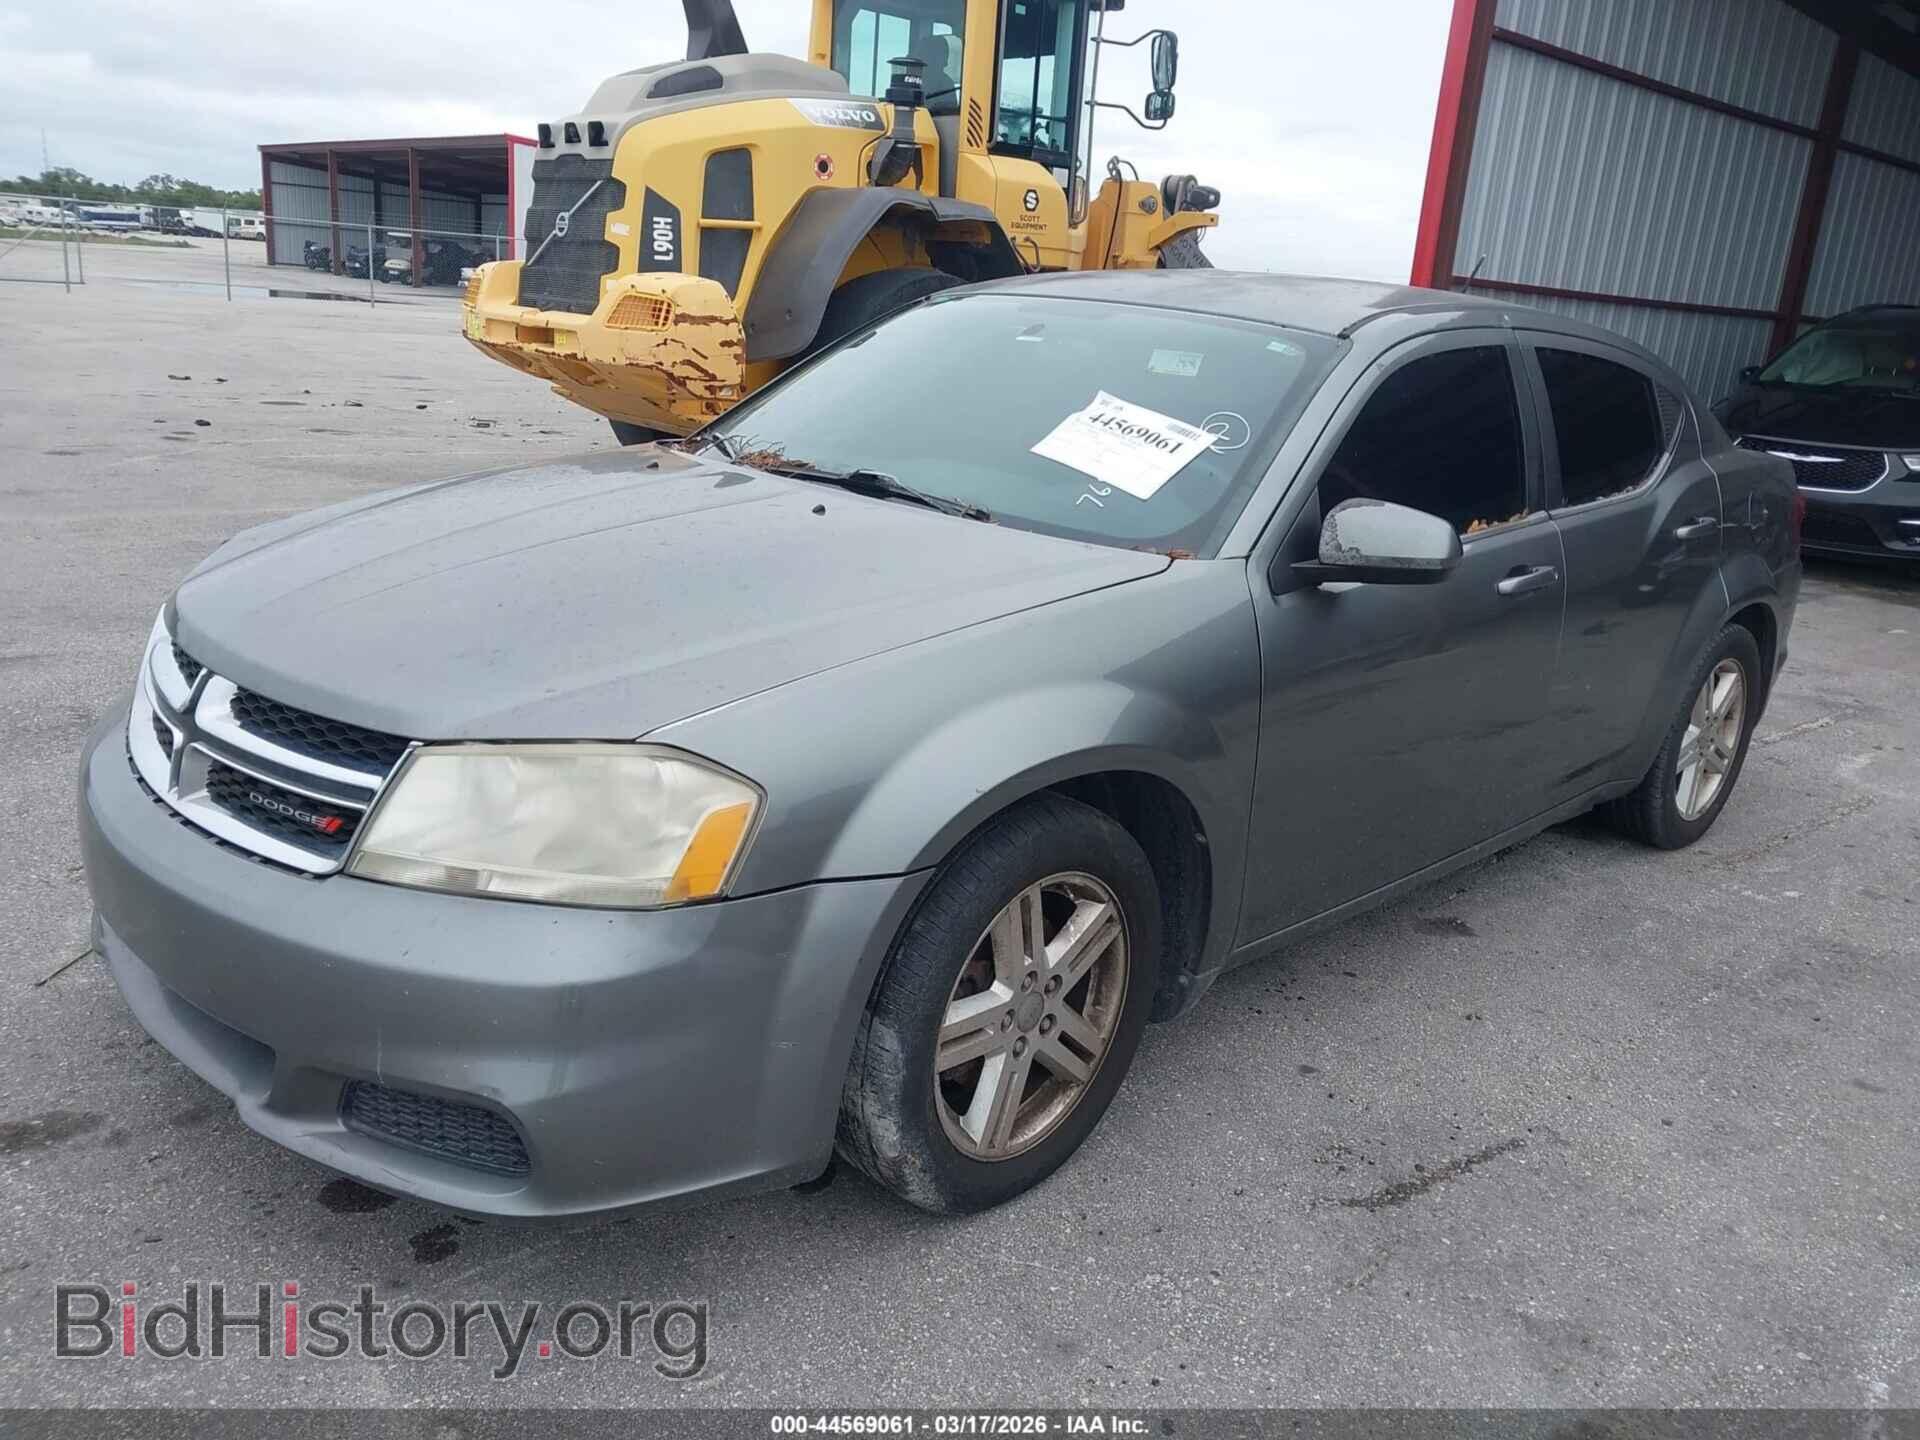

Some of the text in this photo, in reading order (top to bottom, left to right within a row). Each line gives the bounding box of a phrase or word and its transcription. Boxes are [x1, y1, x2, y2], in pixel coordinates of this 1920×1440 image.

[807, 106, 876, 123] VOLVO
[1010, 221, 1048, 231] EQUIPMENT
[1019, 214, 1041, 222] SCOTT
[652, 216, 674, 261] L90H
[1088, 412, 1184, 454] 44569061
[250, 791, 329, 829] DODGE
